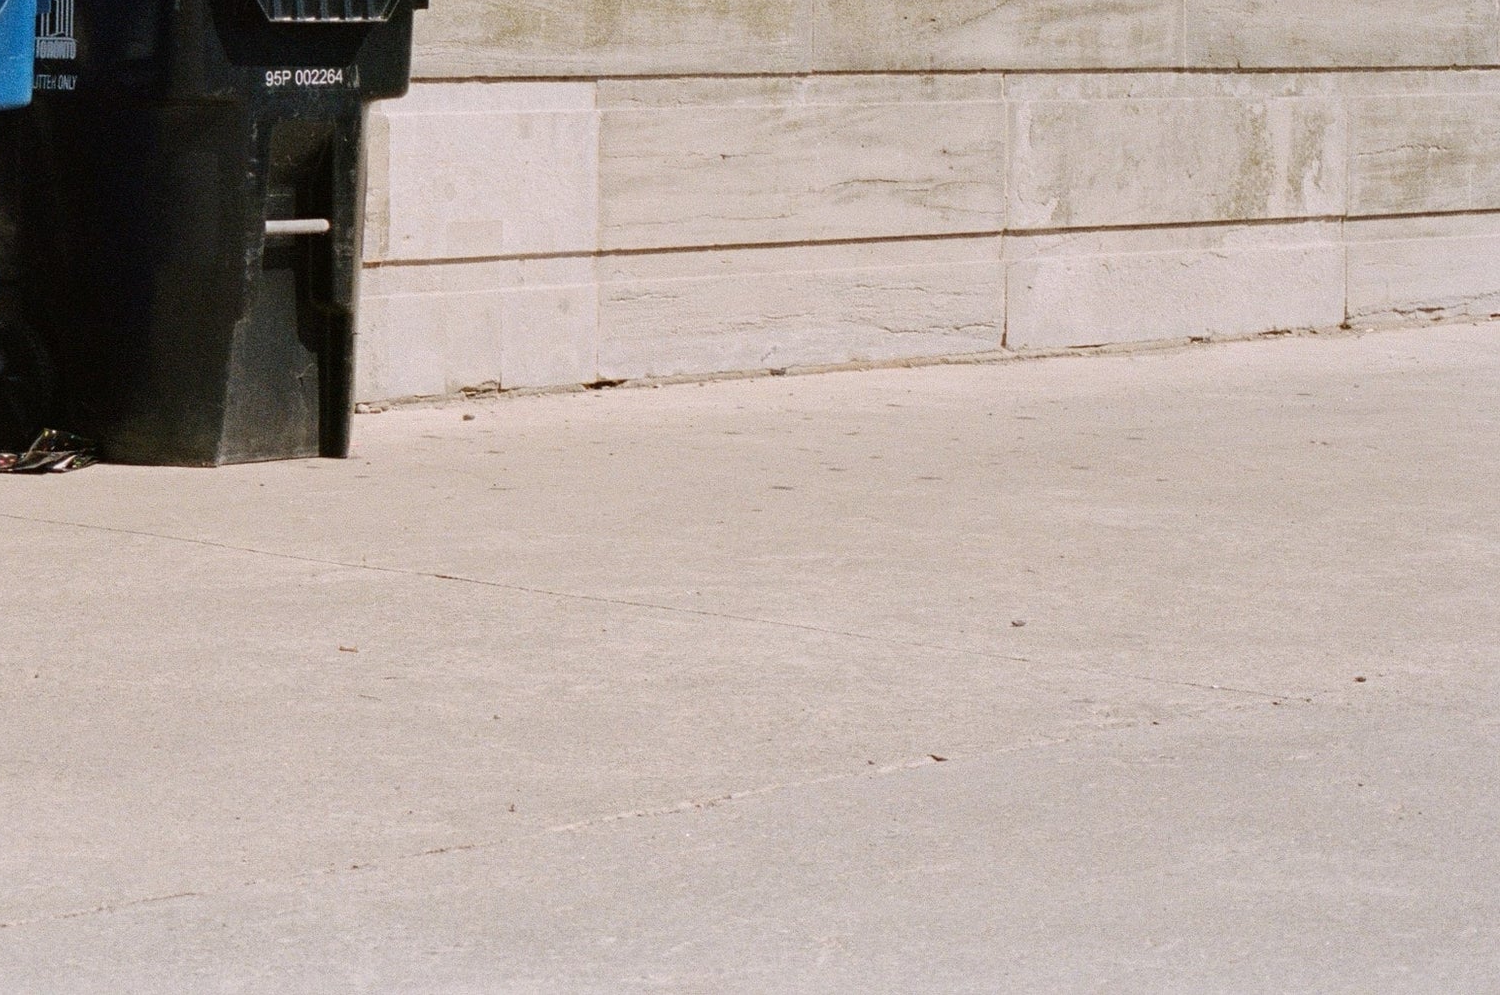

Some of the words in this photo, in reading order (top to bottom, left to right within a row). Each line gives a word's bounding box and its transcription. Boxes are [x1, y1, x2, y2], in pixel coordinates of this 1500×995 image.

[58, 74, 77, 90] ONLY
[265, 70, 292, 87] 95P
[295, 68, 343, 86] 002264
